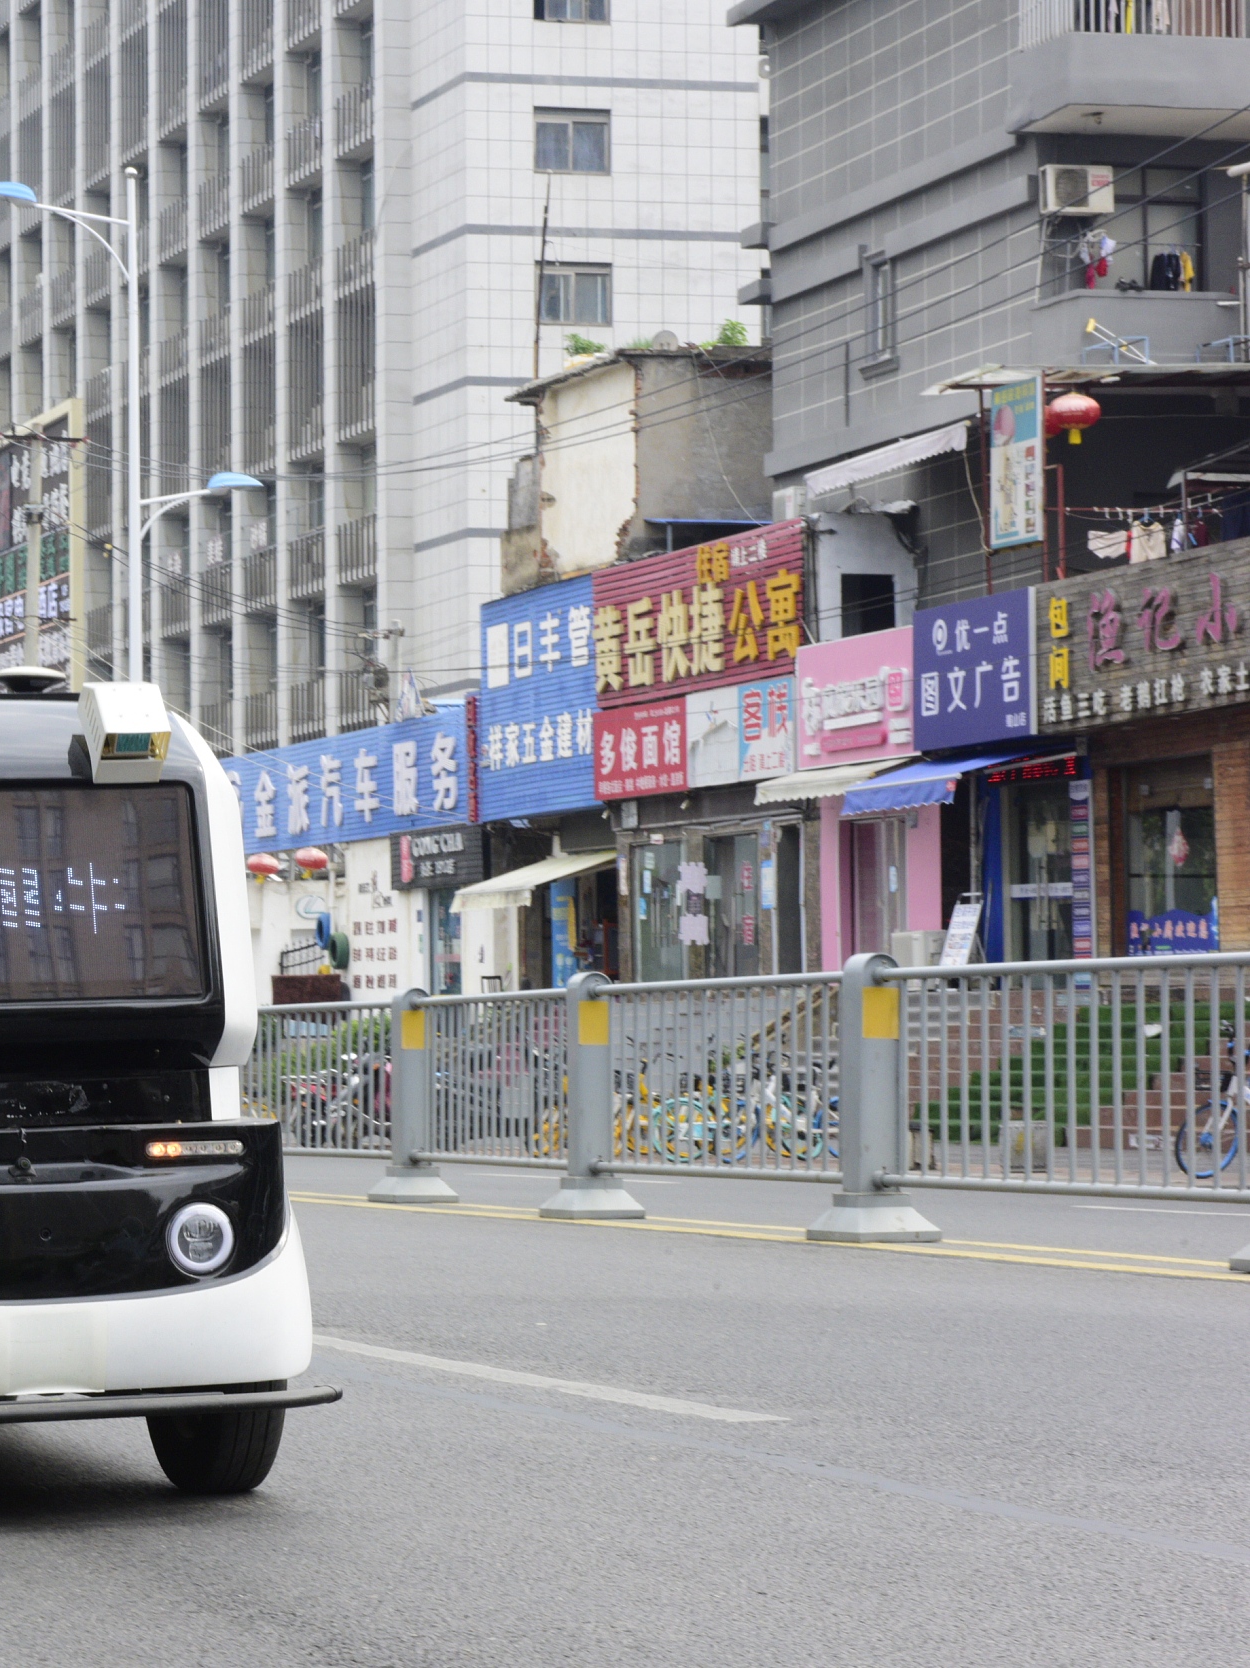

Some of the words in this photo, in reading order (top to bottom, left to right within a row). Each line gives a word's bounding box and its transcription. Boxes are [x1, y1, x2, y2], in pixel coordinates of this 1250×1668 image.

[955, 611, 1009, 652] 优一点
[1049, 596, 1070, 690] 包间
[743, 682, 789, 744] 客栈
[921, 655, 1021, 717] 图文广告
[600, 720, 682, 775] 多俊面馆
